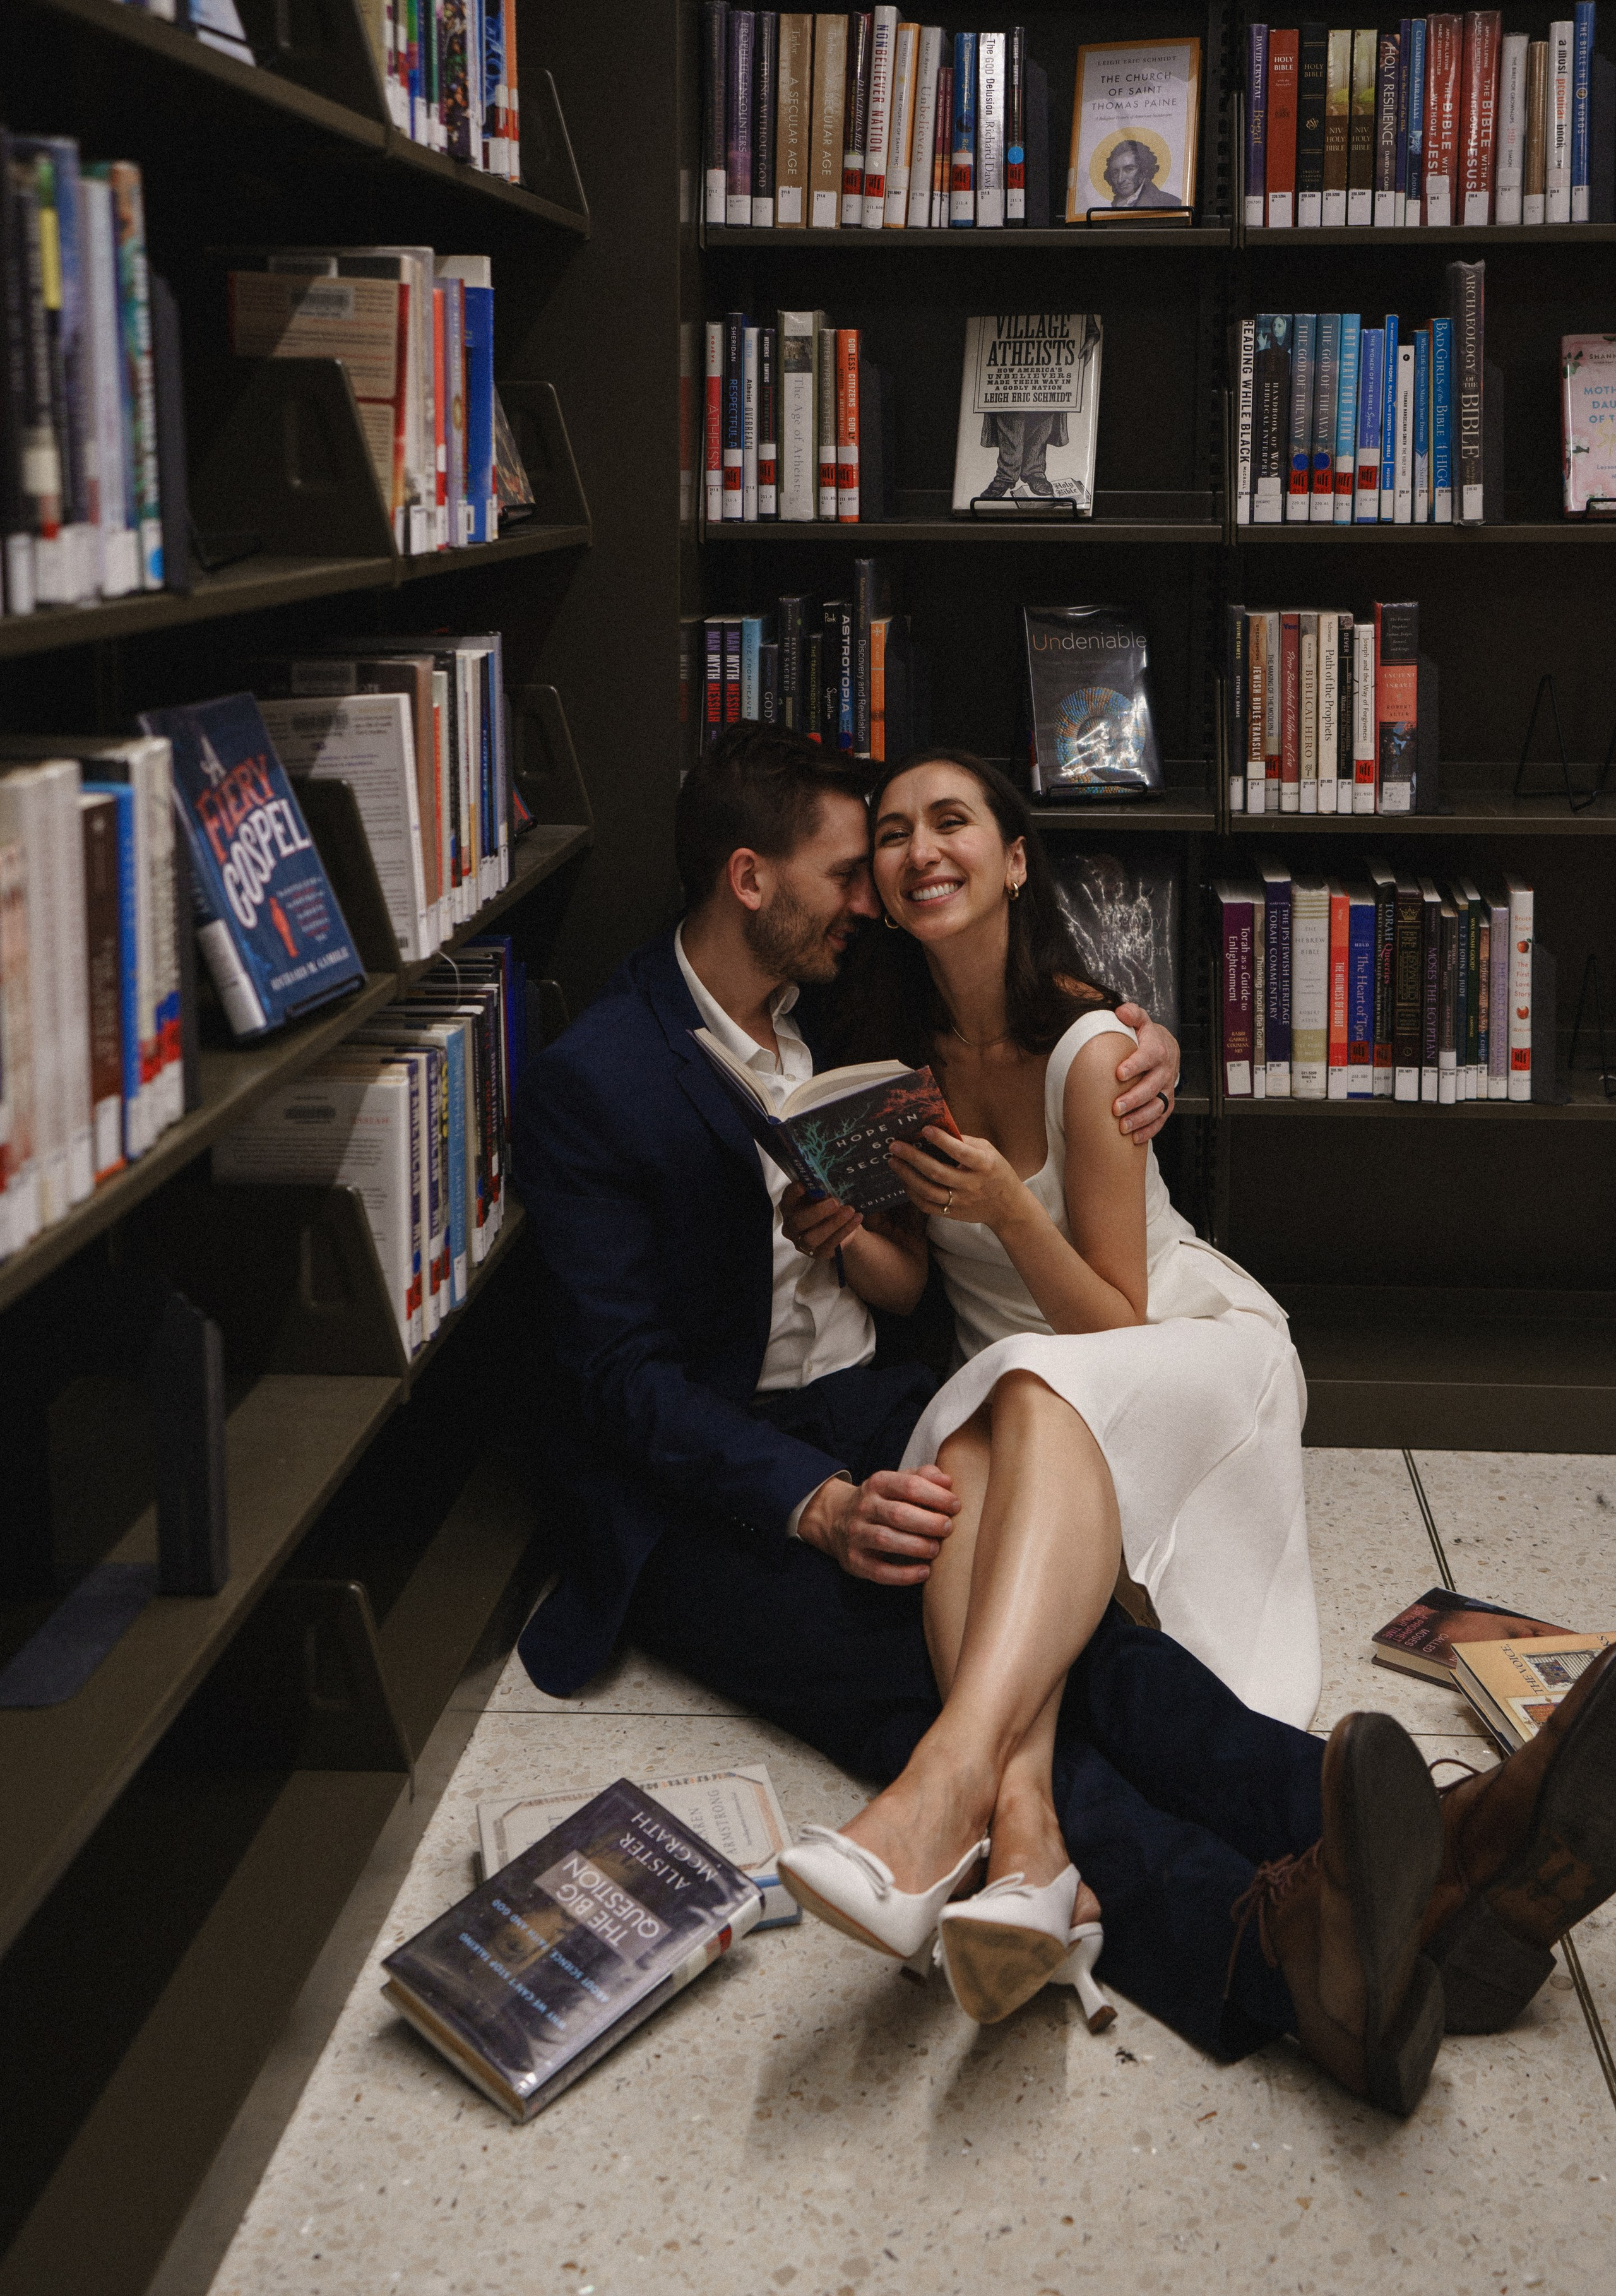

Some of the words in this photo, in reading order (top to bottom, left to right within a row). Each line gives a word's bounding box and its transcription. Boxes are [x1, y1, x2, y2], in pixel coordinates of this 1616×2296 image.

[791, 29, 799, 54] Taylor
[826, 31, 836, 54] Taylor
[987, 40, 995, 54] The
[1414, 30, 1422, 73] CLAIMING
[872, 25, 889, 103] NONBELIEVER
[962, 42, 971, 88] Outgrowing
[985, 57, 994, 74] GOD
[1384, 47, 1395, 79] HOLY
[1558, 50, 1567, 74] most
[760, 61, 768, 100] LIVING
[824, 78, 832, 86] A
[1126, 72, 1171, 82] CHURCH
[963, 92, 971, 109] God
[985, 79, 995, 115] Delusion
[1129, 86, 1162, 95] SAINT
[1557, 79, 1566, 119] peculiar
[1092, 101, 1138, 110] THOMAS
[1145, 98, 1176, 108] PAINE
[1382, 85, 1394, 145] RESILIENCE
[788, 92, 798, 144] SECULAR
[823, 92, 832, 145] SECULAR
[869, 110, 884, 152] NATION
[917, 86, 931, 162] Unbelievers
[1251, 109, 1264, 145] Begat
[759, 105, 768, 159] WITHOUT
[1557, 124, 1566, 148] book
[758, 163, 766, 187] GOD
[787, 150, 797, 175] AGE
[822, 151, 831, 175] AGE
[996, 315, 1071, 339] VILLAGE
[1466, 271, 1475, 371] ARCHAEOLOGY
[1242, 321, 1254, 374] READING
[1298, 324, 1308, 345] THE
[1322, 324, 1332, 345] THE
[1345, 328, 1355, 346] NOT
[1436, 322, 1447, 347] BAD
[986, 340, 1075, 367] ATHEISTS
[1297, 348, 1307, 372] GOD
[1321, 349, 1331, 372] GOD
[1343, 354, 1355, 379] WHAT
[1435, 349, 1447, 384] GIRLS
[795, 377, 804, 399] The
[1297, 375, 1306, 390] OF
[1321, 375, 1331, 390] OF
[1341, 386, 1353, 403] YOU
[728, 379, 738, 436] RESPECTFUL
[984, 393, 1009, 403] LEIGH
[1011, 393, 1030, 402] ERIC
[1033, 392, 1071, 402] SCHMIDT
[1241, 380, 1252, 418] WHILE
[1296, 393, 1305, 415] THE
[1320, 393, 1330, 415] THE
[792, 404, 803, 423] Age
[1340, 411, 1352, 441] THINK
[1436, 405, 1446, 436] BIBLE
[1461, 393, 1479, 459] BIBLE
[707, 404, 718, 470] ATHEISM
[744, 407, 753, 449] OVERREACH
[794, 430, 804, 441] of
[1295, 415, 1305, 440] WAY
[1318, 415, 1329, 440] WAY
[1240, 424, 1251, 463] BLACK
[793, 446, 803, 493] Atheists
[708, 631, 720, 650] MAN
[727, 631, 739, 651] MAN
[1032, 631, 1146, 651] Undeniable
[708, 655, 720, 679] MYTH
[727, 655, 739, 680] MYTH
[842, 615, 850, 712] ASTROTOPIA
[857, 640, 865, 679] Discovery
[1326, 650, 1334, 669] Path
[1326, 672, 1334, 681] of
[708, 683, 720, 722] MESSIAH
[727, 684, 739, 723] MESSIAH
[1305, 670, 1313, 722] BIBLICAL
[1325, 684, 1334, 697] the
[764, 692, 773, 718] GOD
[1322, 701, 1333, 741] Prophets
[200, 734, 227, 786] A
[195, 754, 275, 865] FIERY
[222, 799, 312, 929] GOSPEL
[1281, 927, 1290, 941] JPS
[1385, 901, 1394, 941] TORAH
[1241, 927, 1250, 953] Torah
[1226, 936, 1238, 1001] Enlightenment
[1255, 956, 1264, 988] Thinking
[1281, 943, 1290, 975] JEWISH
[1335, 962, 1345, 973] THE
[1381, 943, 1393, 984] Queeries
[1427, 947, 1437, 979] MOSES
[1240, 972, 1249, 1001] Guide
[1335, 974, 1344, 1000] HOLINESS
[1427, 984, 1437, 1002] THE
[1281, 980, 1290, 1025] HERITAGE
[1334, 1010, 1343, 1027] DOUBT
[1427, 1008, 1436, 1059] EGYPTIAN
[836, 1124, 888, 1148] HOPE
[898, 1114, 917, 1125] IN
[1405, 1629, 1430, 1646] MOSES
[1423, 1633, 1449, 1653] CALLED
[1500, 1644, 1526, 1674] VOICE,
[1523, 1675, 1544, 1694] THE
[619, 1832, 692, 1890] ALISTER
[556, 1883, 595, 1916] BIG
[562, 1857, 660, 1938] QUESTION
[587, 1909, 628, 1947] THE
[458, 1931, 492, 1962] TALKING
[489, 1960, 511, 1980] STOP
[508, 1978, 535, 2001] CAN'T
[532, 1999, 547, 2014] WE
